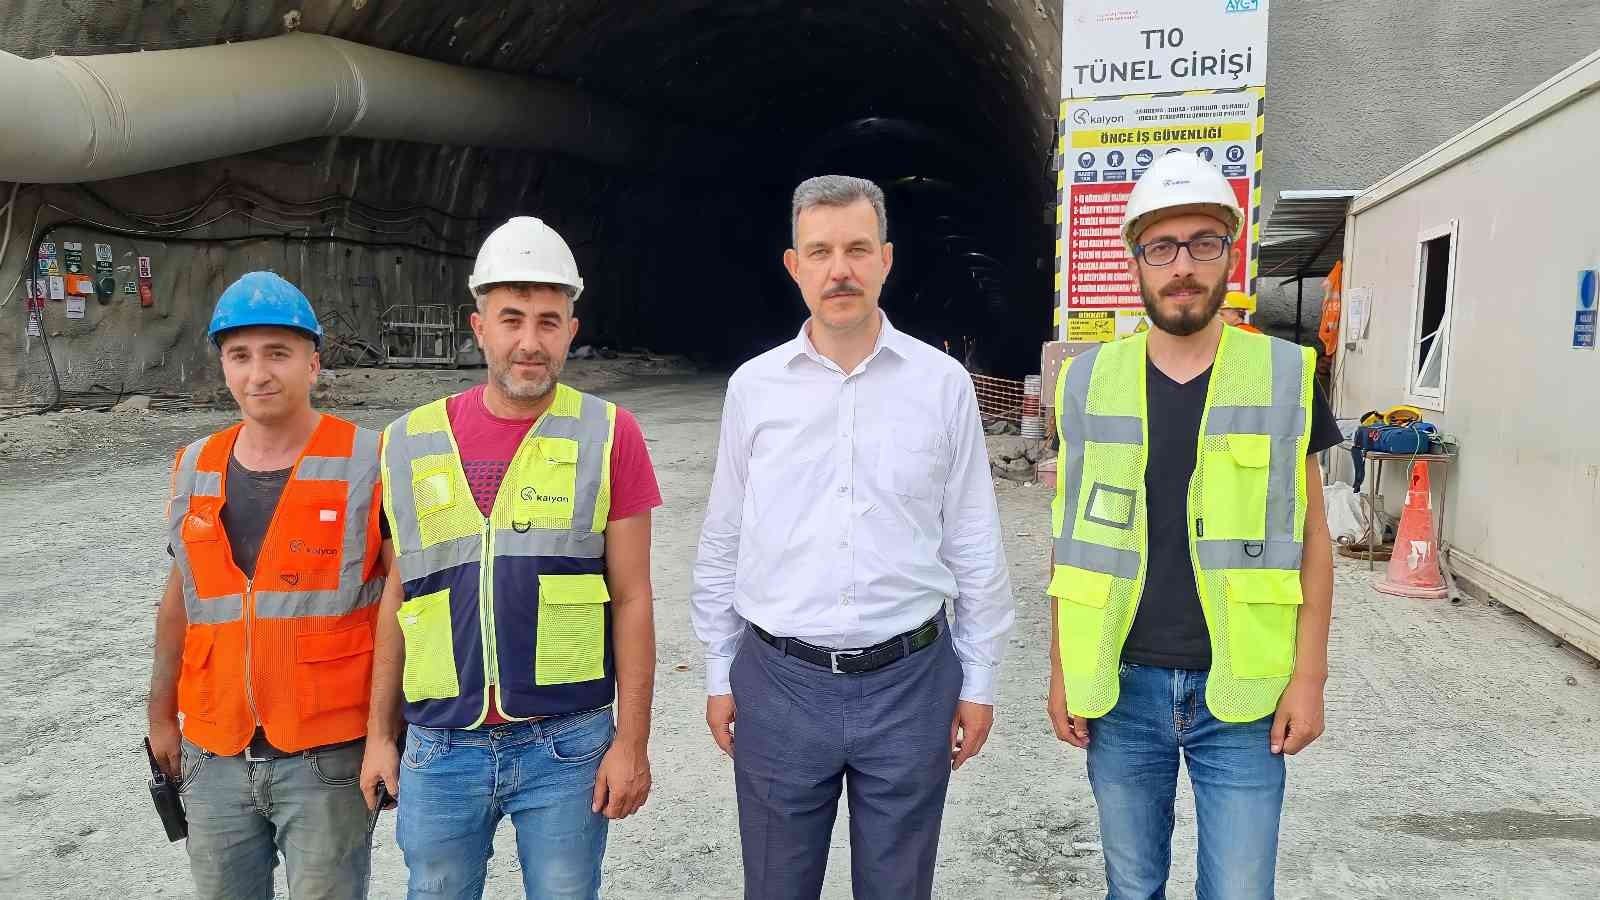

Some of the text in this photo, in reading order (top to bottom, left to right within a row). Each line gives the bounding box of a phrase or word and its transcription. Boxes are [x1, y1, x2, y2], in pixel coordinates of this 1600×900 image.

[1141, 28, 1184, 50] T10
[1073, 47, 1252, 84] TÜNEL GİRİŞİ
[1090, 113, 1124, 127] kalyon
[1100, 125, 1222, 145] ÖNCE İŞ GÜVENLİĞİ
[536, 493, 569, 503] kalyon
